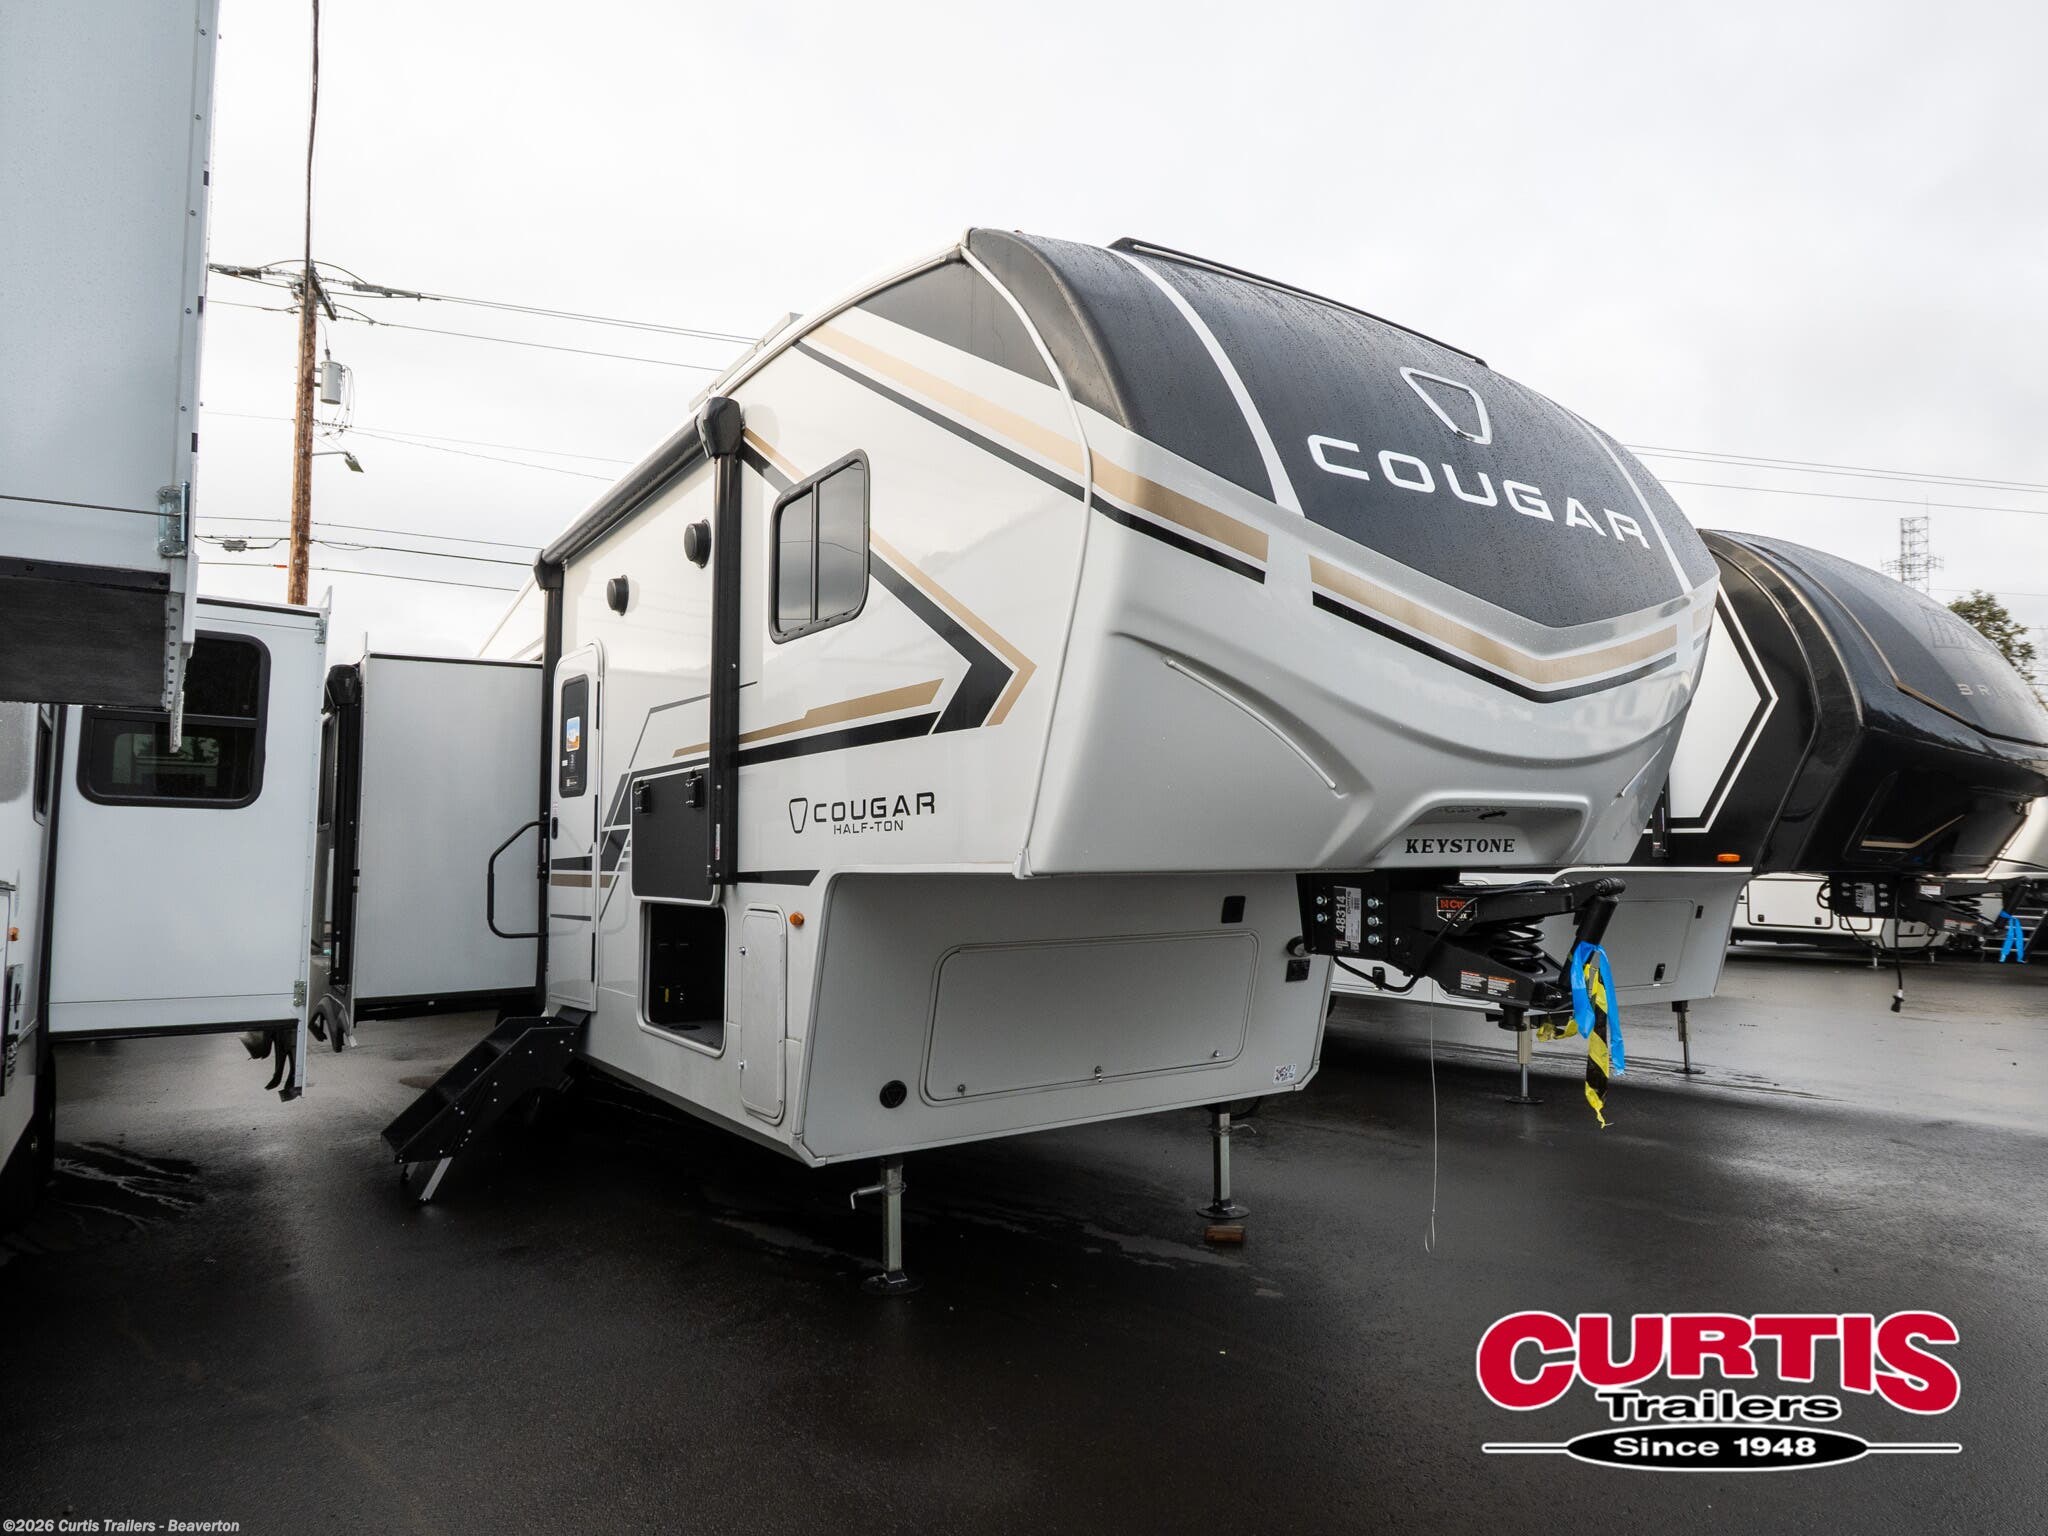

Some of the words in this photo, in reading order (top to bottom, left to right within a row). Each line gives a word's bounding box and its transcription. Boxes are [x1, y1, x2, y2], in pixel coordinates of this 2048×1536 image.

[1307, 434, 1650, 549] COUGAR
[814, 792, 935, 822] COUGAR
[833, 820, 904, 835] HALF-TON
[1404, 838, 1516, 854] KEYSTONE
[1335, 895, 1346, 933] 48314
